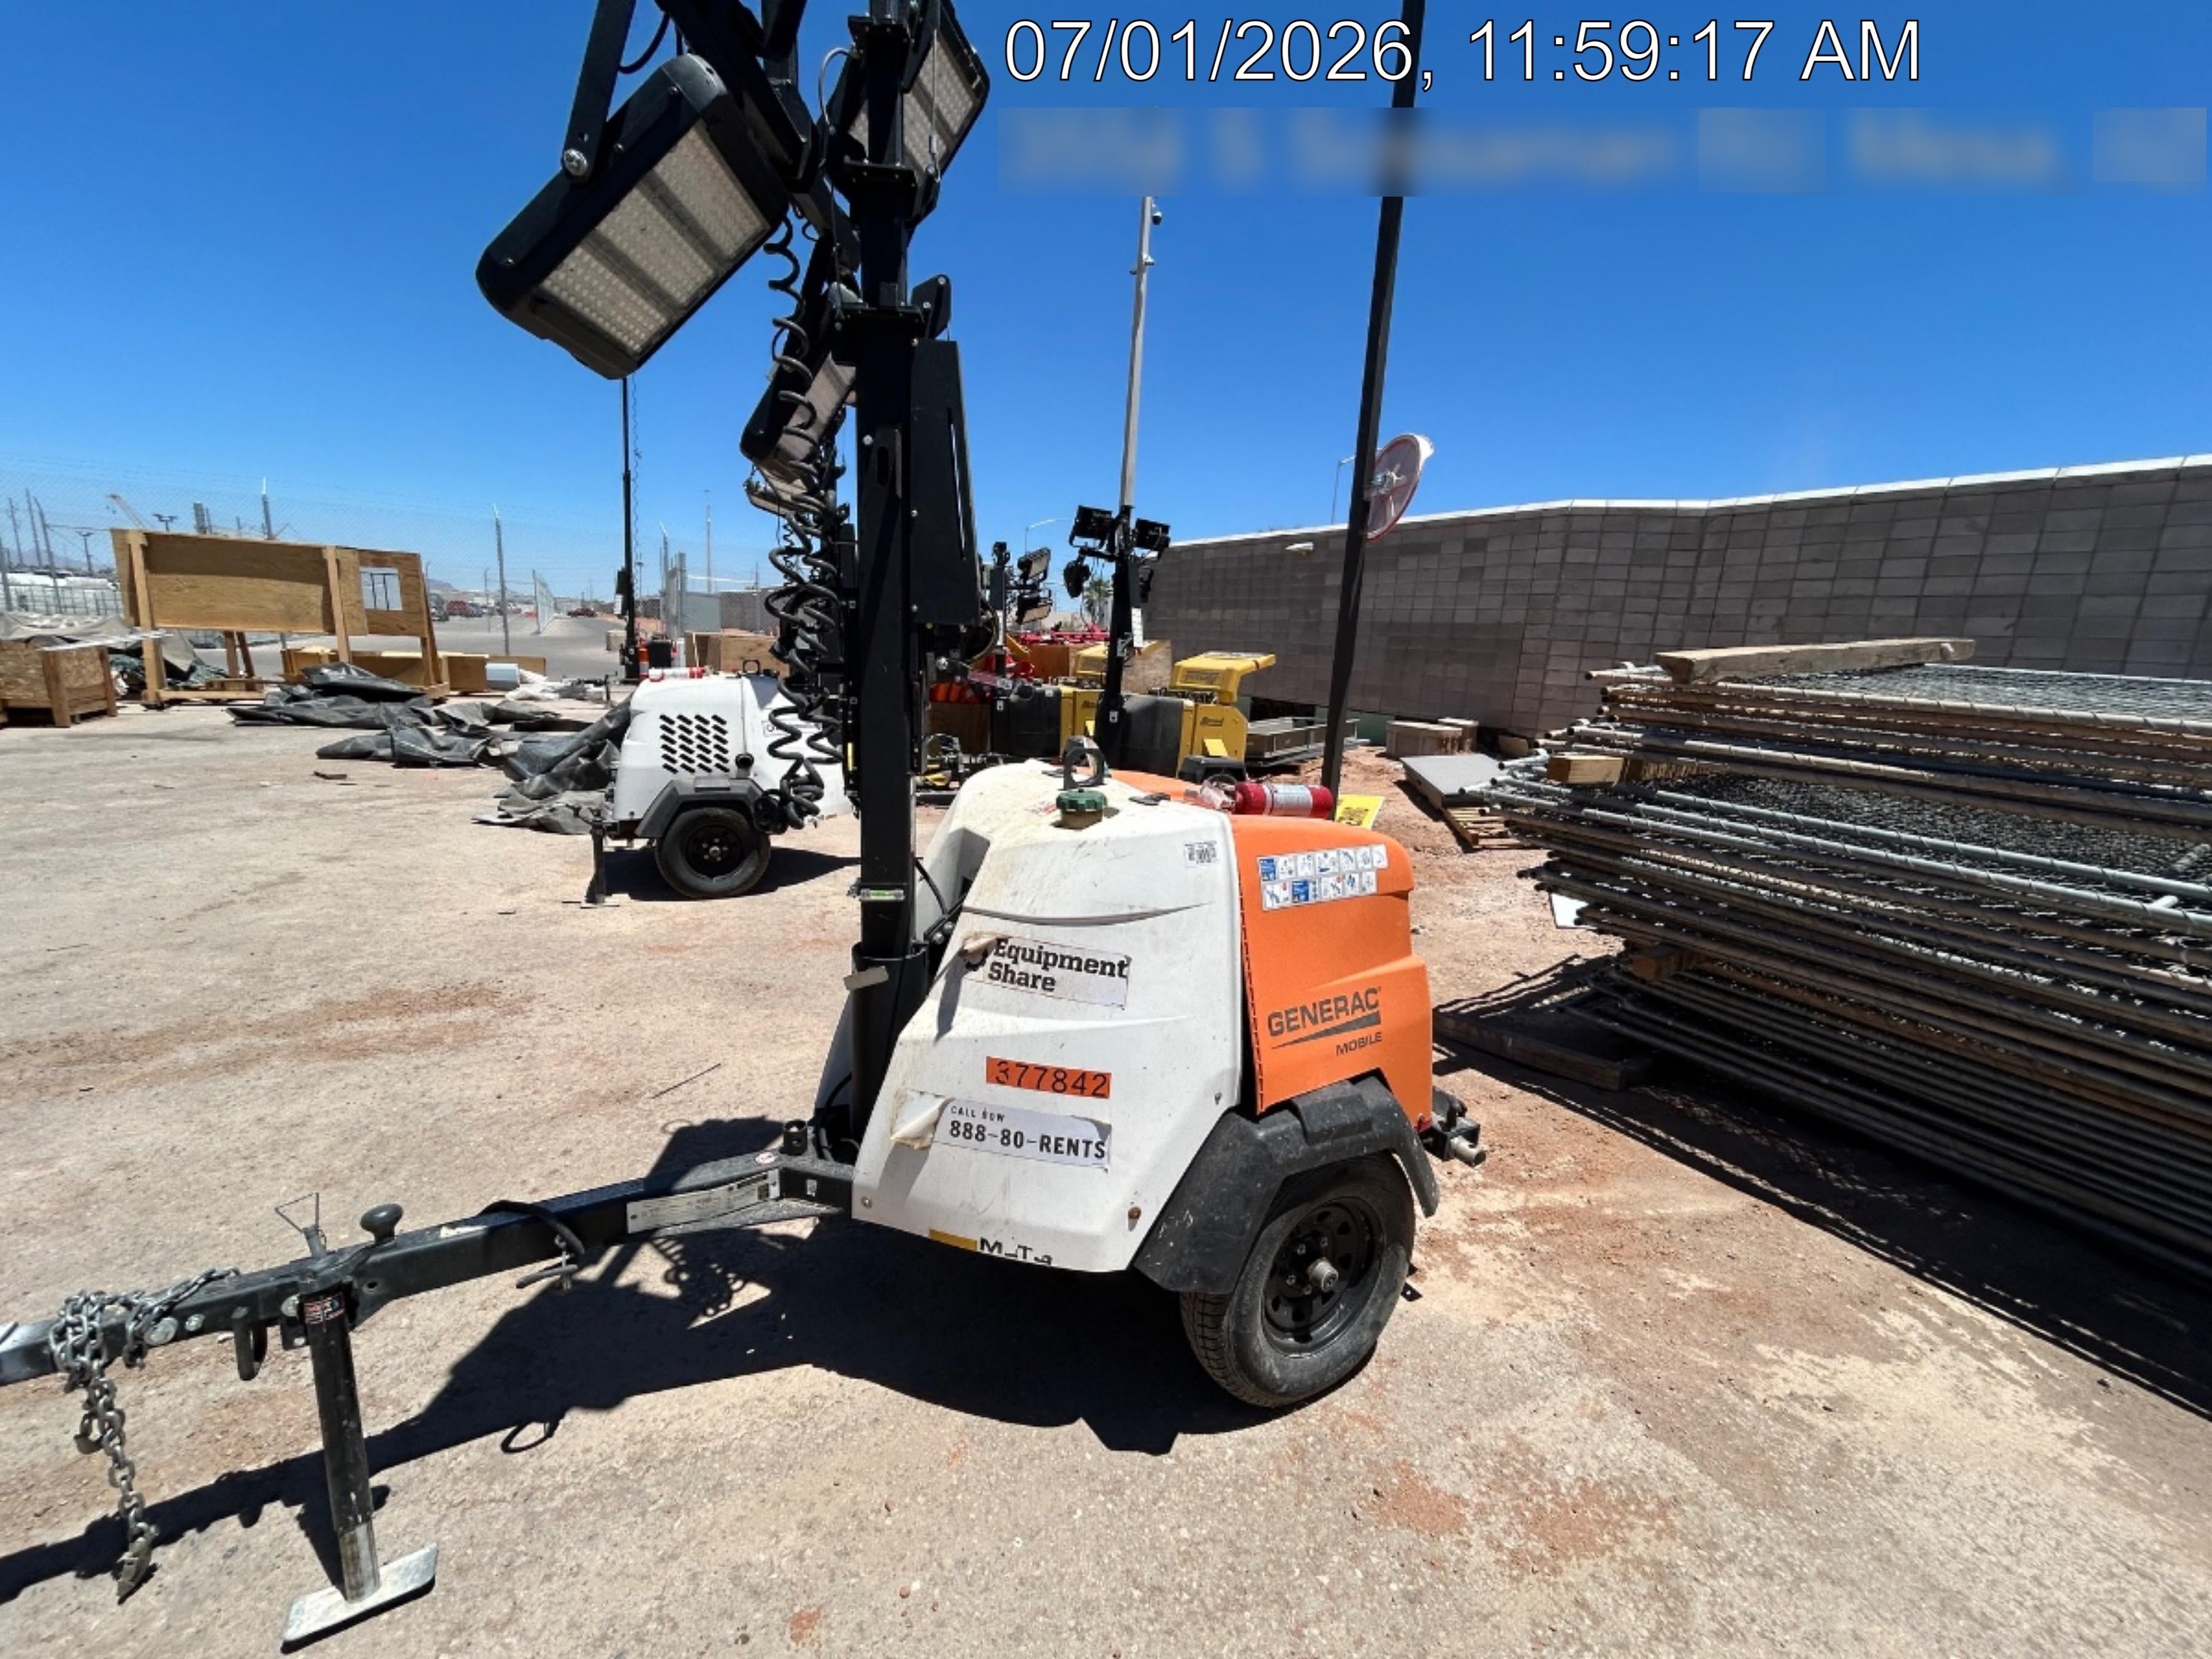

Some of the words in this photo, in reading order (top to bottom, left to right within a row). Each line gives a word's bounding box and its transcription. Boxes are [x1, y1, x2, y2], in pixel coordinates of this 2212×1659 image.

[994, 938, 1128, 978] Equipment
[988, 962, 1056, 992] Share
[1268, 987, 1379, 1037] GENERAC
[1336, 1032, 1381, 1056] MOBILE
[995, 1061, 1107, 1098] 377842
[951, 1105, 976, 1118] CALL
[949, 1120, 1105, 1159] 888-80-RENTS
